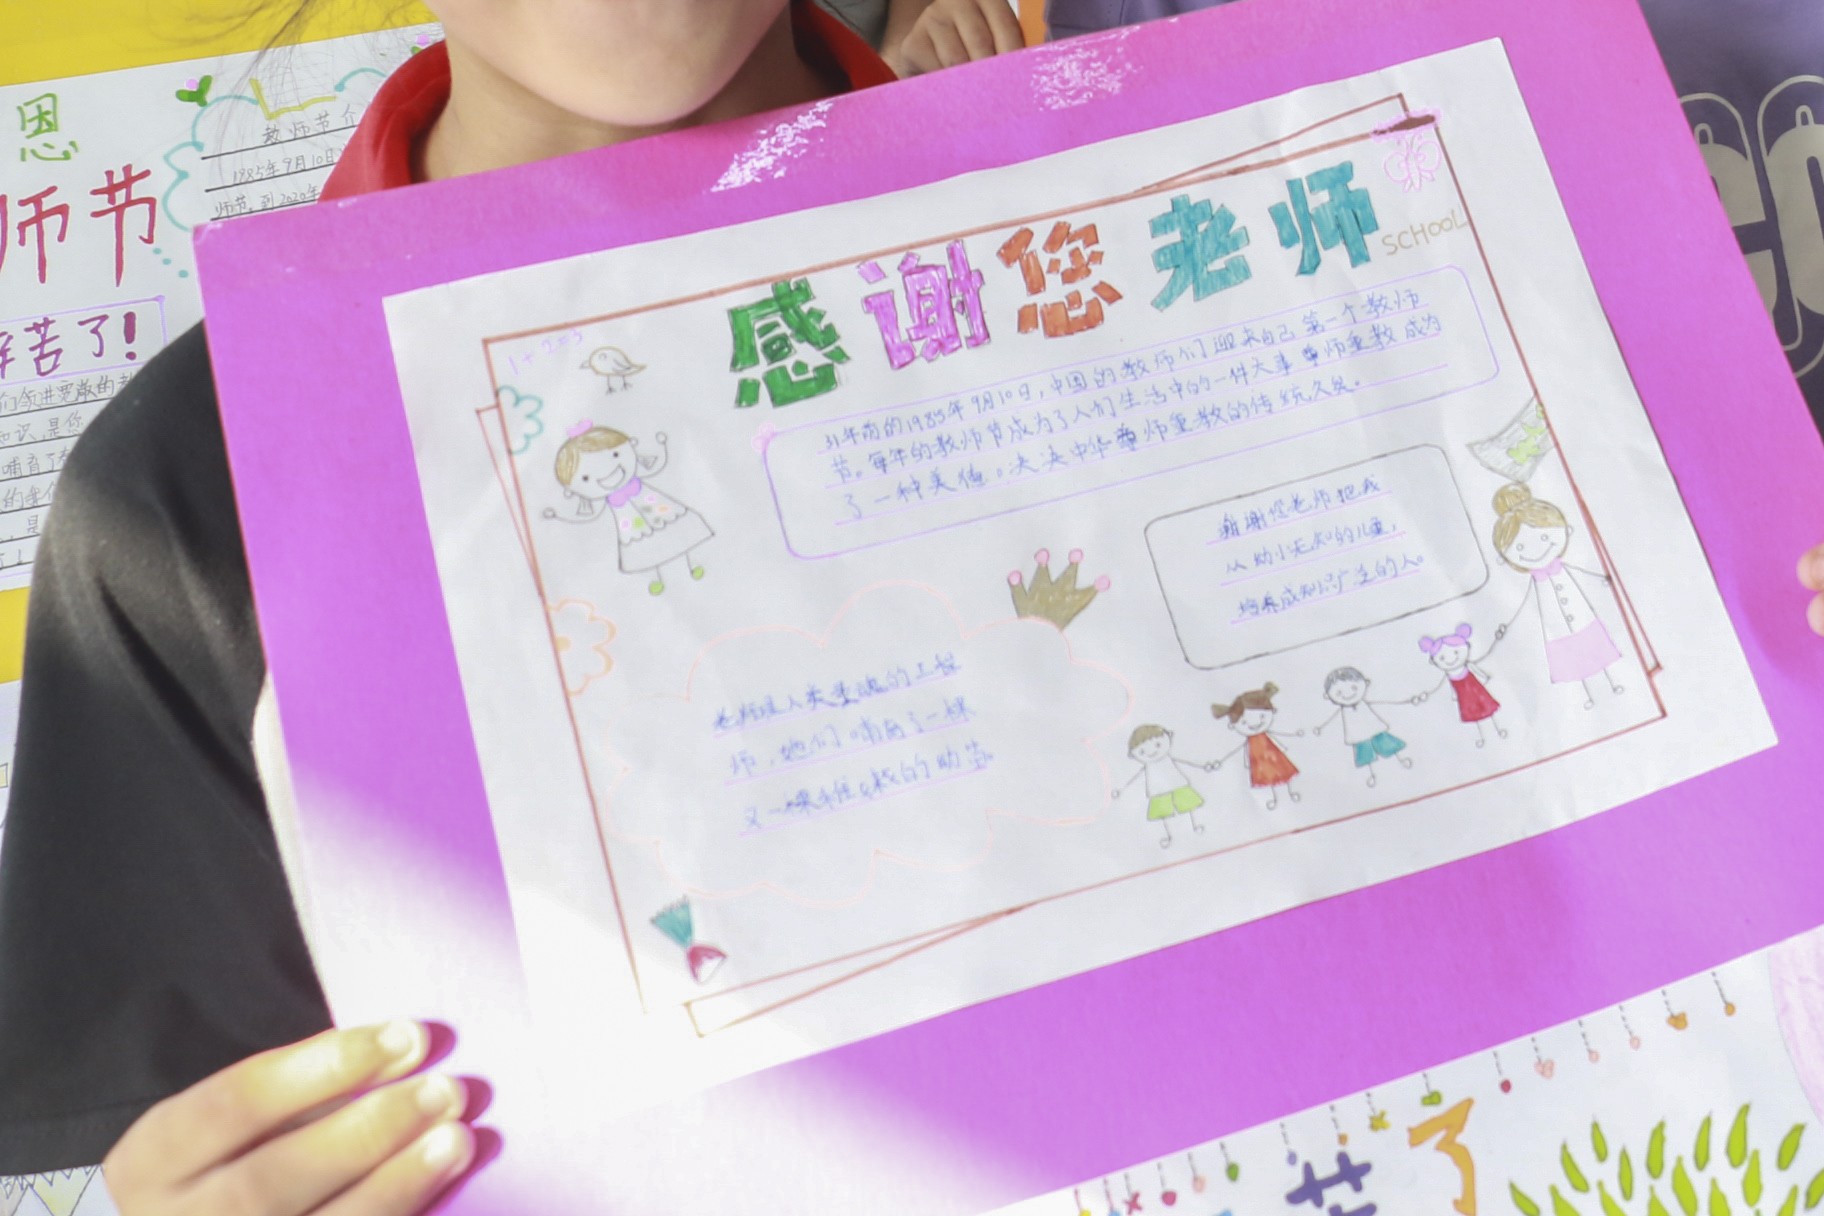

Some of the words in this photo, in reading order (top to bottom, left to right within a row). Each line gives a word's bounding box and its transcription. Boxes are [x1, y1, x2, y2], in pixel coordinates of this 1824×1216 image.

[17, 92, 79, 162] 恩
[232, 145, 344, 183] 1985年9月10日
[1382, 208, 1468, 257] SCHOOL
[726, 160, 1381, 410] 感谢您老师
